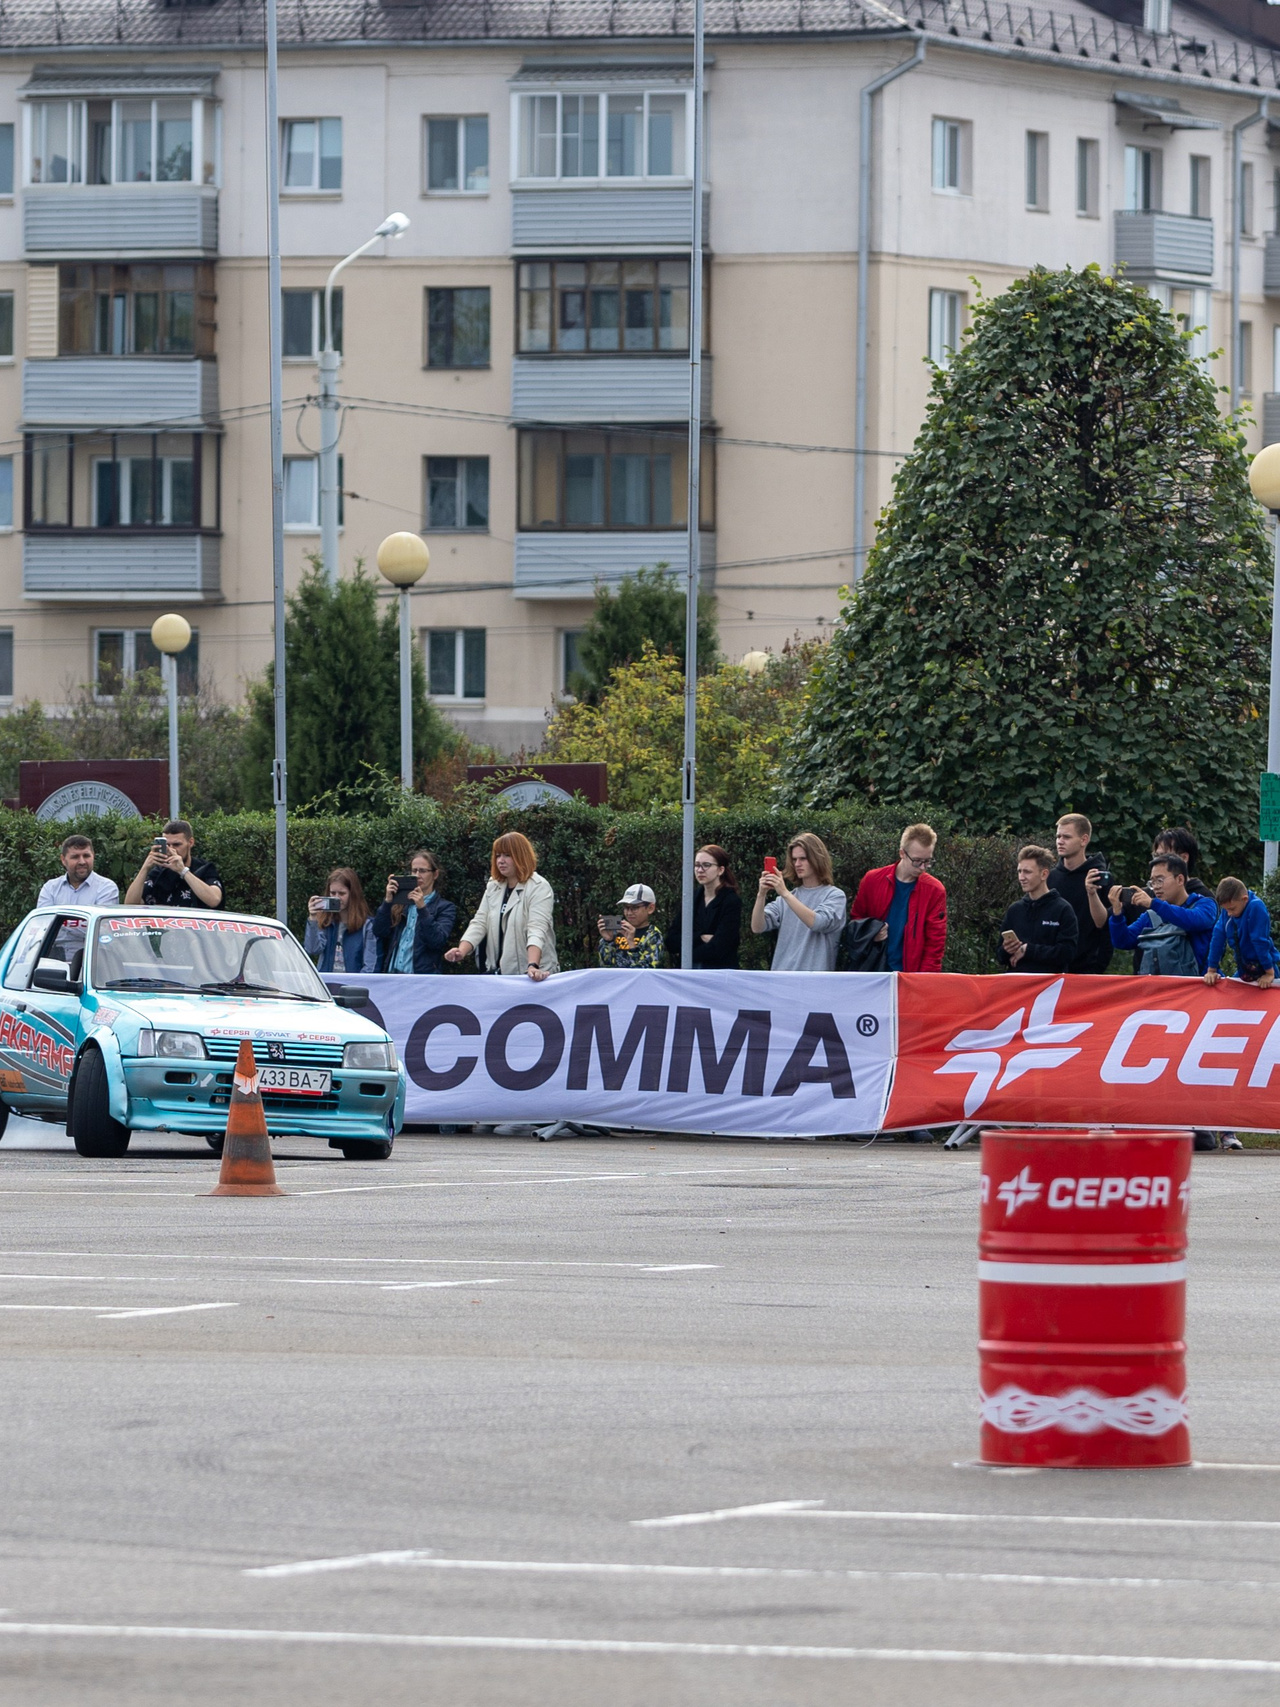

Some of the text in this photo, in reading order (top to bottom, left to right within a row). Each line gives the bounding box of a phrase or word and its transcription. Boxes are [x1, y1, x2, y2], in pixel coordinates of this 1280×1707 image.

[109, 917, 283, 941] NAKAYAMA
[309, 1034, 336, 1042] CEPSA
[405, 1004, 856, 1098] COMMA
[256, 1069, 286, 1087] 433
[1047, 1176, 1172, 1209] CEPSA
